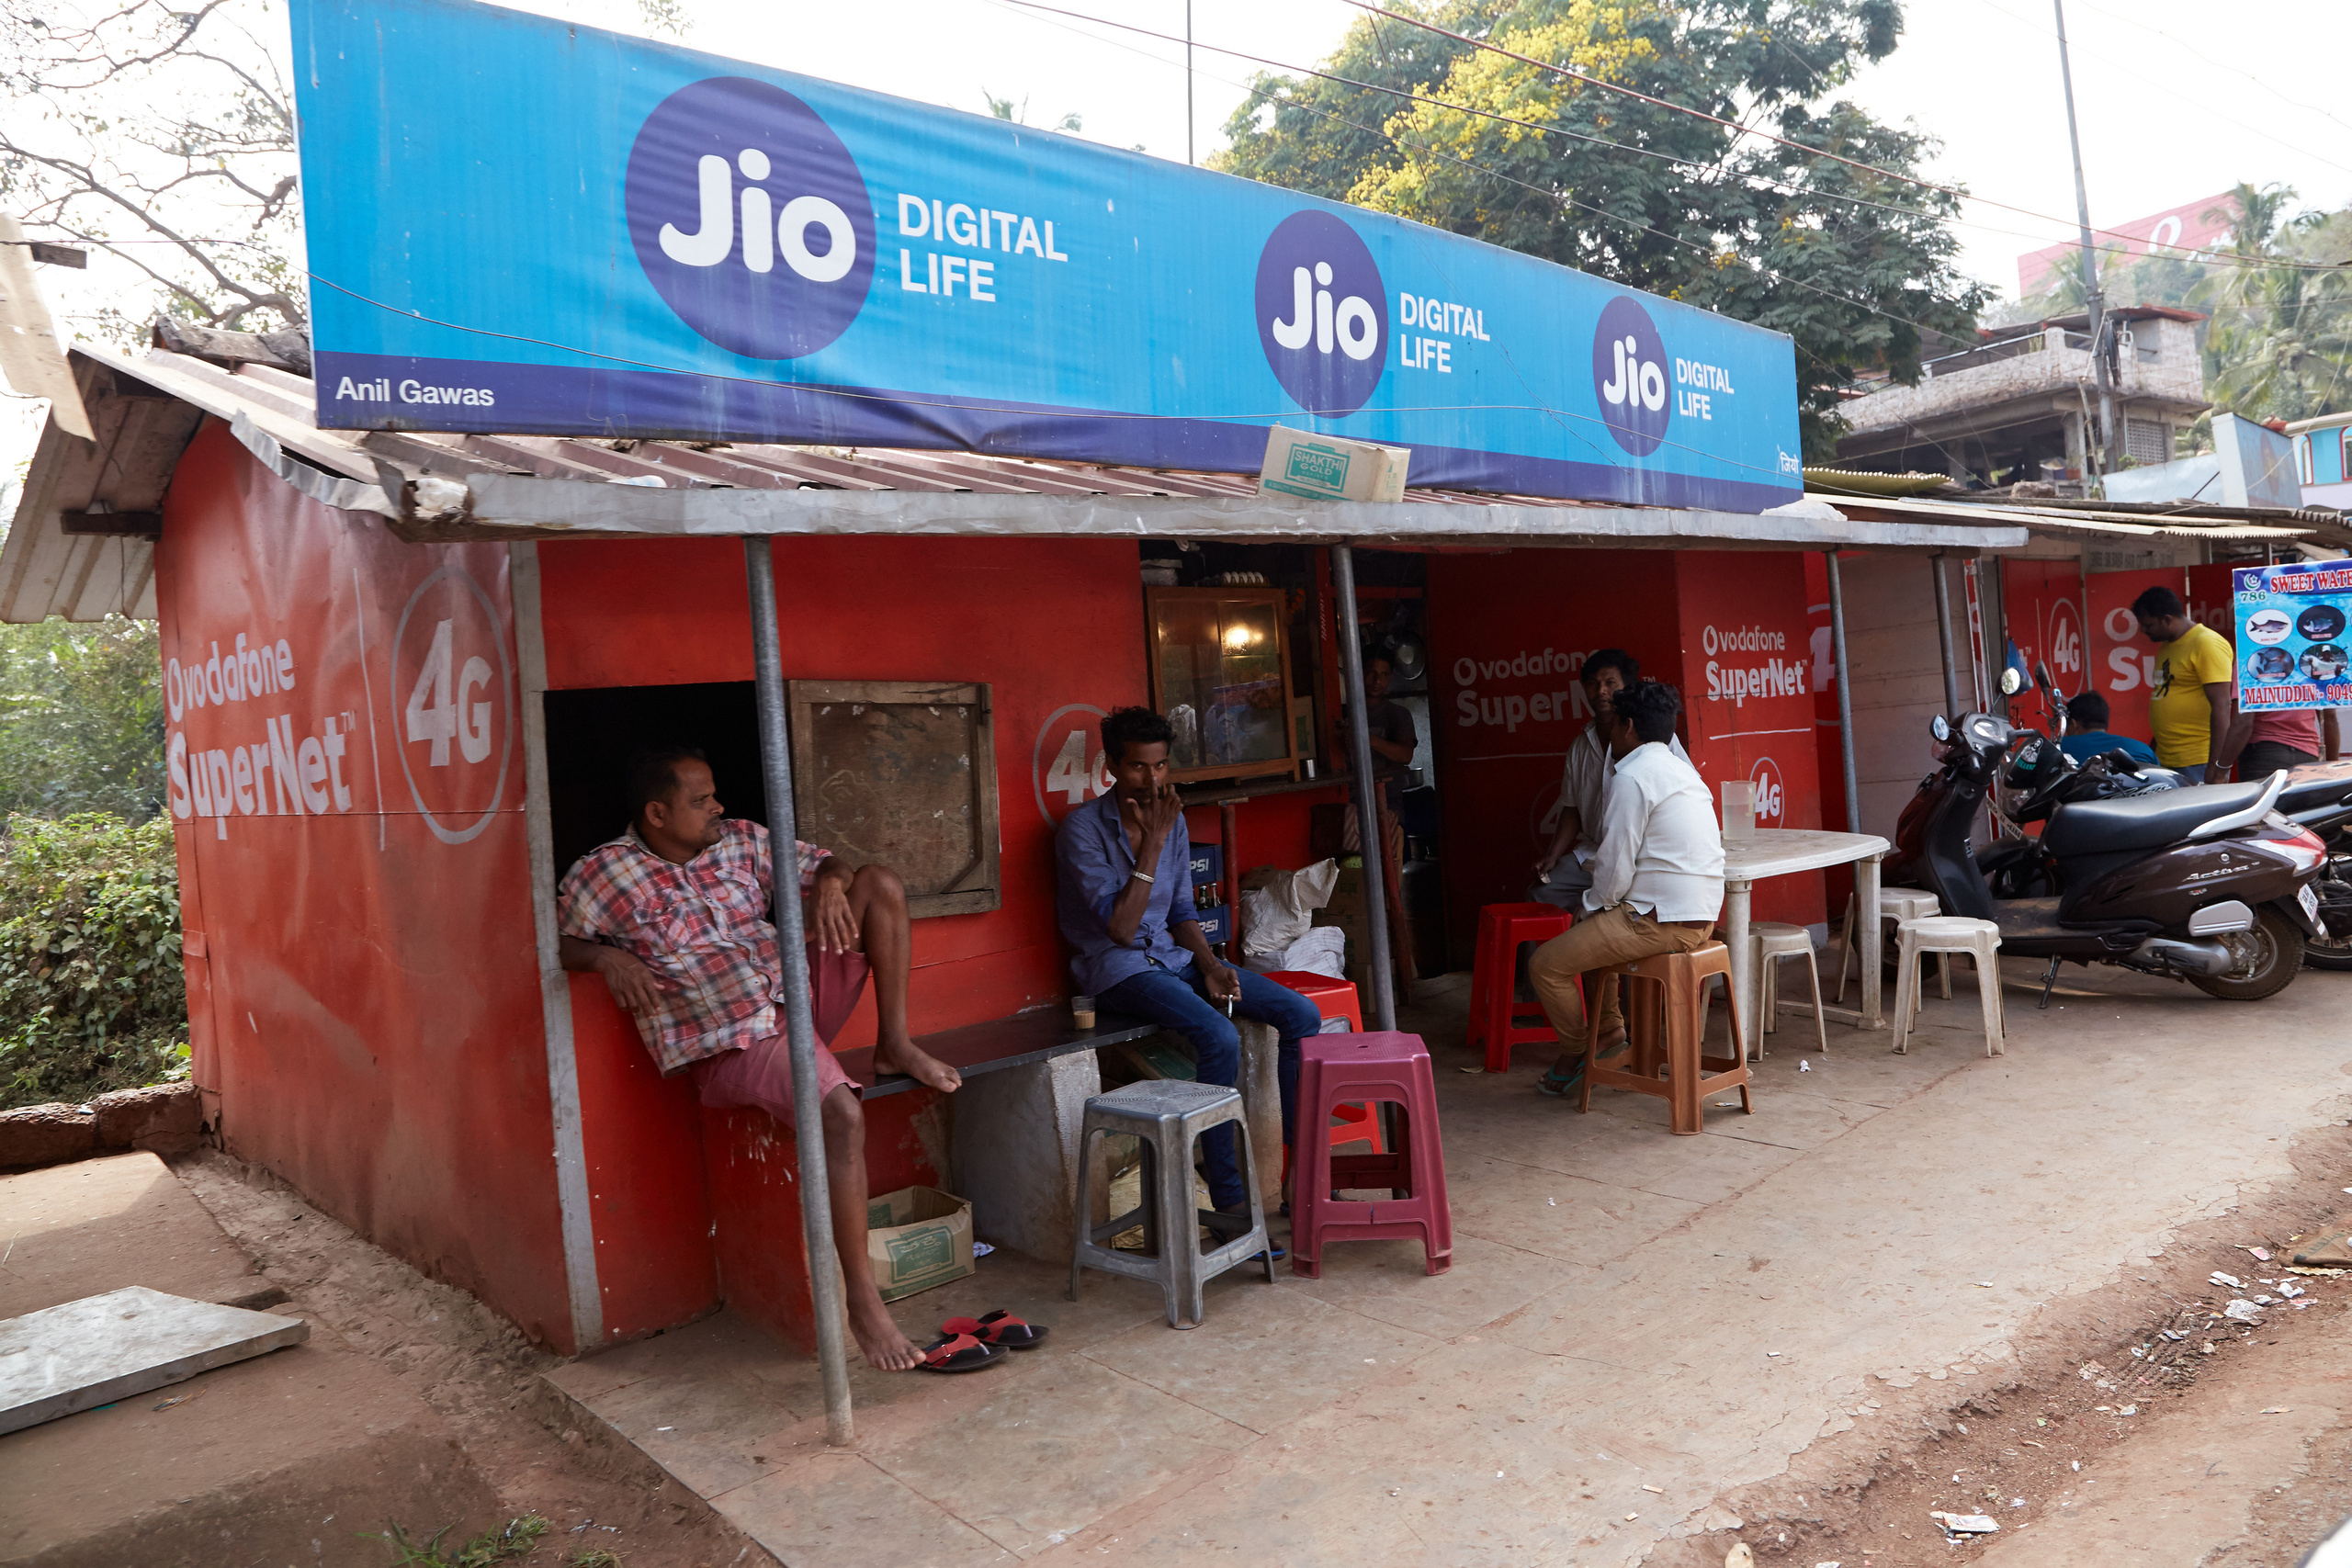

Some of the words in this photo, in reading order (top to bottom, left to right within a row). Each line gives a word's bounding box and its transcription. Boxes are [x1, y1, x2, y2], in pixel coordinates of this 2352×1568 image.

[659, 149, 856, 282] Jio
[898, 193, 1069, 262] DIGITAL
[900, 249, 996, 302] LIFE
[1272, 261, 1378, 361] Jio
[1400, 292, 1490, 342] DIGITAL
[1400, 333, 1452, 373] LIFE
[335, 376, 391, 402] Anil
[399, 379, 495, 407] Gawas
[1603, 335, 1666, 412] Jio
[1676, 357, 1735, 394] DIGITAL
[1678, 389, 1712, 421] LIFE
[1295, 450, 1343, 471] SHAKTHI
[1300, 462, 1333, 476] GOLD
[1780, 451, 1799, 475] जियो
[2241, 591, 2267, 602] 786
[2270, 573, 2314, 593] SWEET
[1719, 626, 1785, 653] vodafone
[2054, 617, 2080, 673] 4G
[184, 632, 295, 711] vodafone
[1478, 647, 1600, 682] vodafon
[406, 618, 493, 767] 4G
[1457, 679, 1597, 733] SuperN
[1755, 773, 1781, 820] 4G
[1189, 858, 1209, 873] PSI
[1198, 919, 1219, 933] PSI
